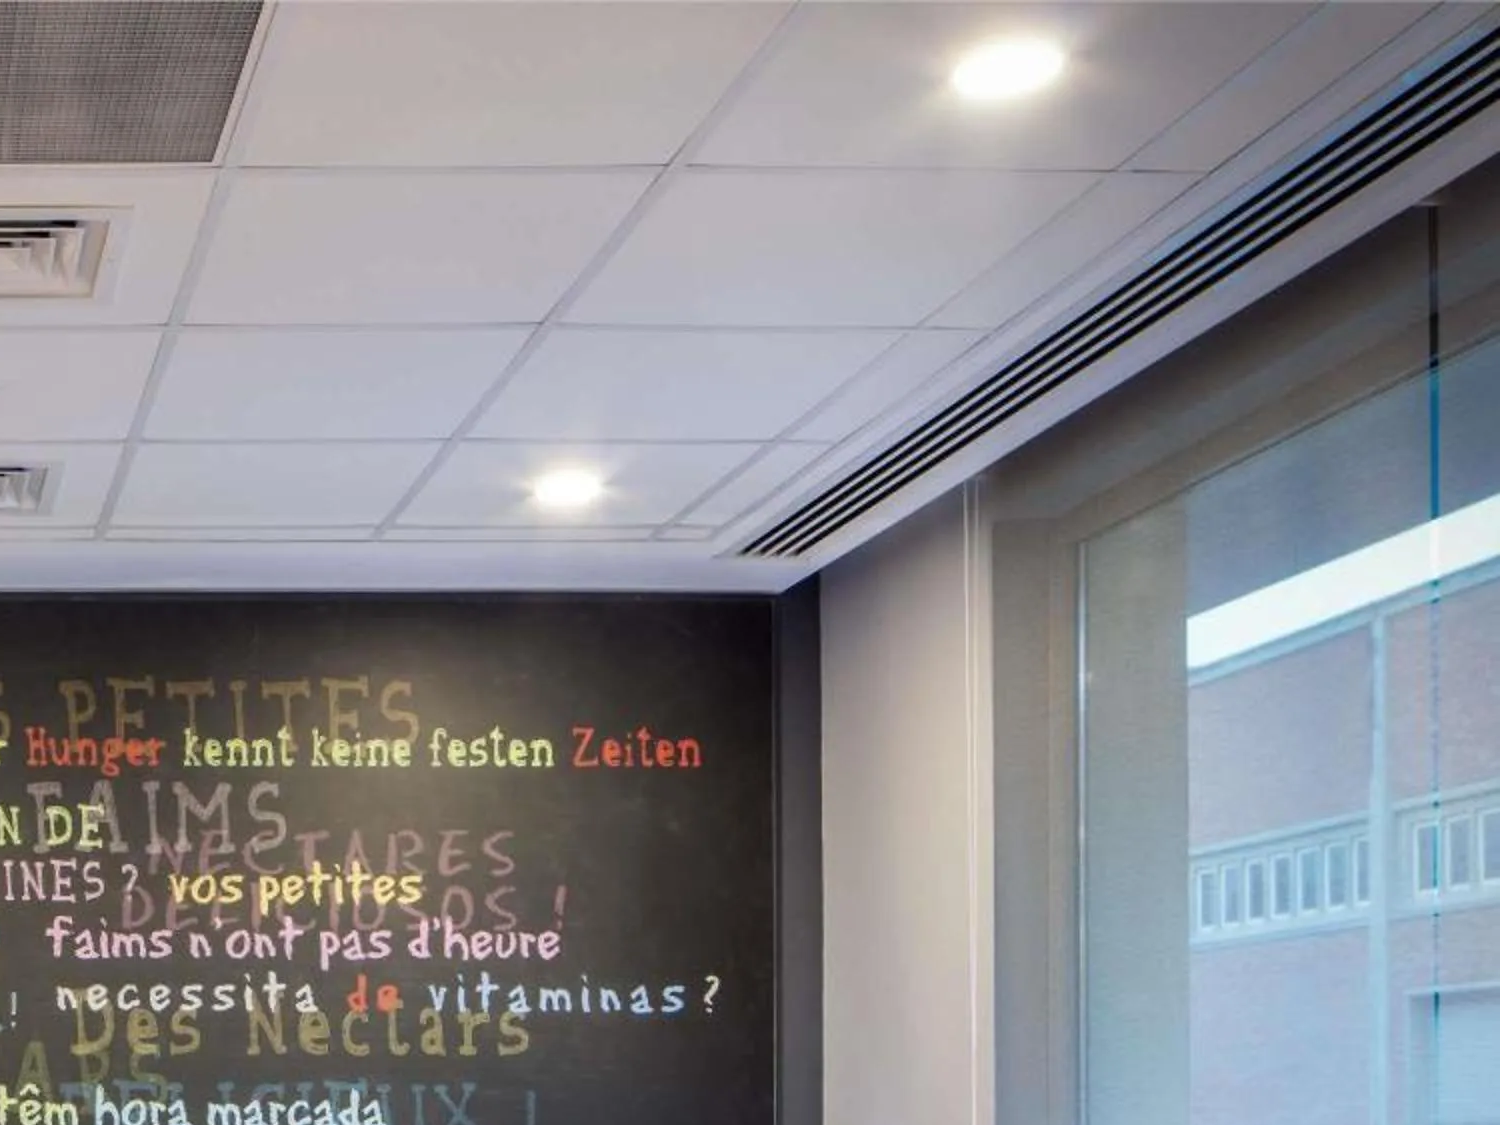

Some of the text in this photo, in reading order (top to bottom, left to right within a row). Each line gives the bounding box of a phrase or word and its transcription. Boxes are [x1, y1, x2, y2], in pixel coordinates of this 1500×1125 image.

[58, 676, 420, 752] PETITES
[25, 727, 165, 777] Hunger
[183, 727, 296, 768] kennt
[311, 728, 412, 768] keine
[430, 728, 555, 768] festen
[572, 726, 702, 768] Zeiten
[26, 781, 287, 854] FAIMS
[45, 804, 104, 848] DE
[169, 861, 424, 916] vos petites
[46, 916, 173, 960] faims
[320, 930, 392, 971] pas
[407, 916, 561, 960] d'heure
[56, 972, 318, 1013] necessita
[347, 974, 399, 1012] de
[429, 971, 686, 1014] vitaminas
[71, 990, 530, 1056] Des Nectars
